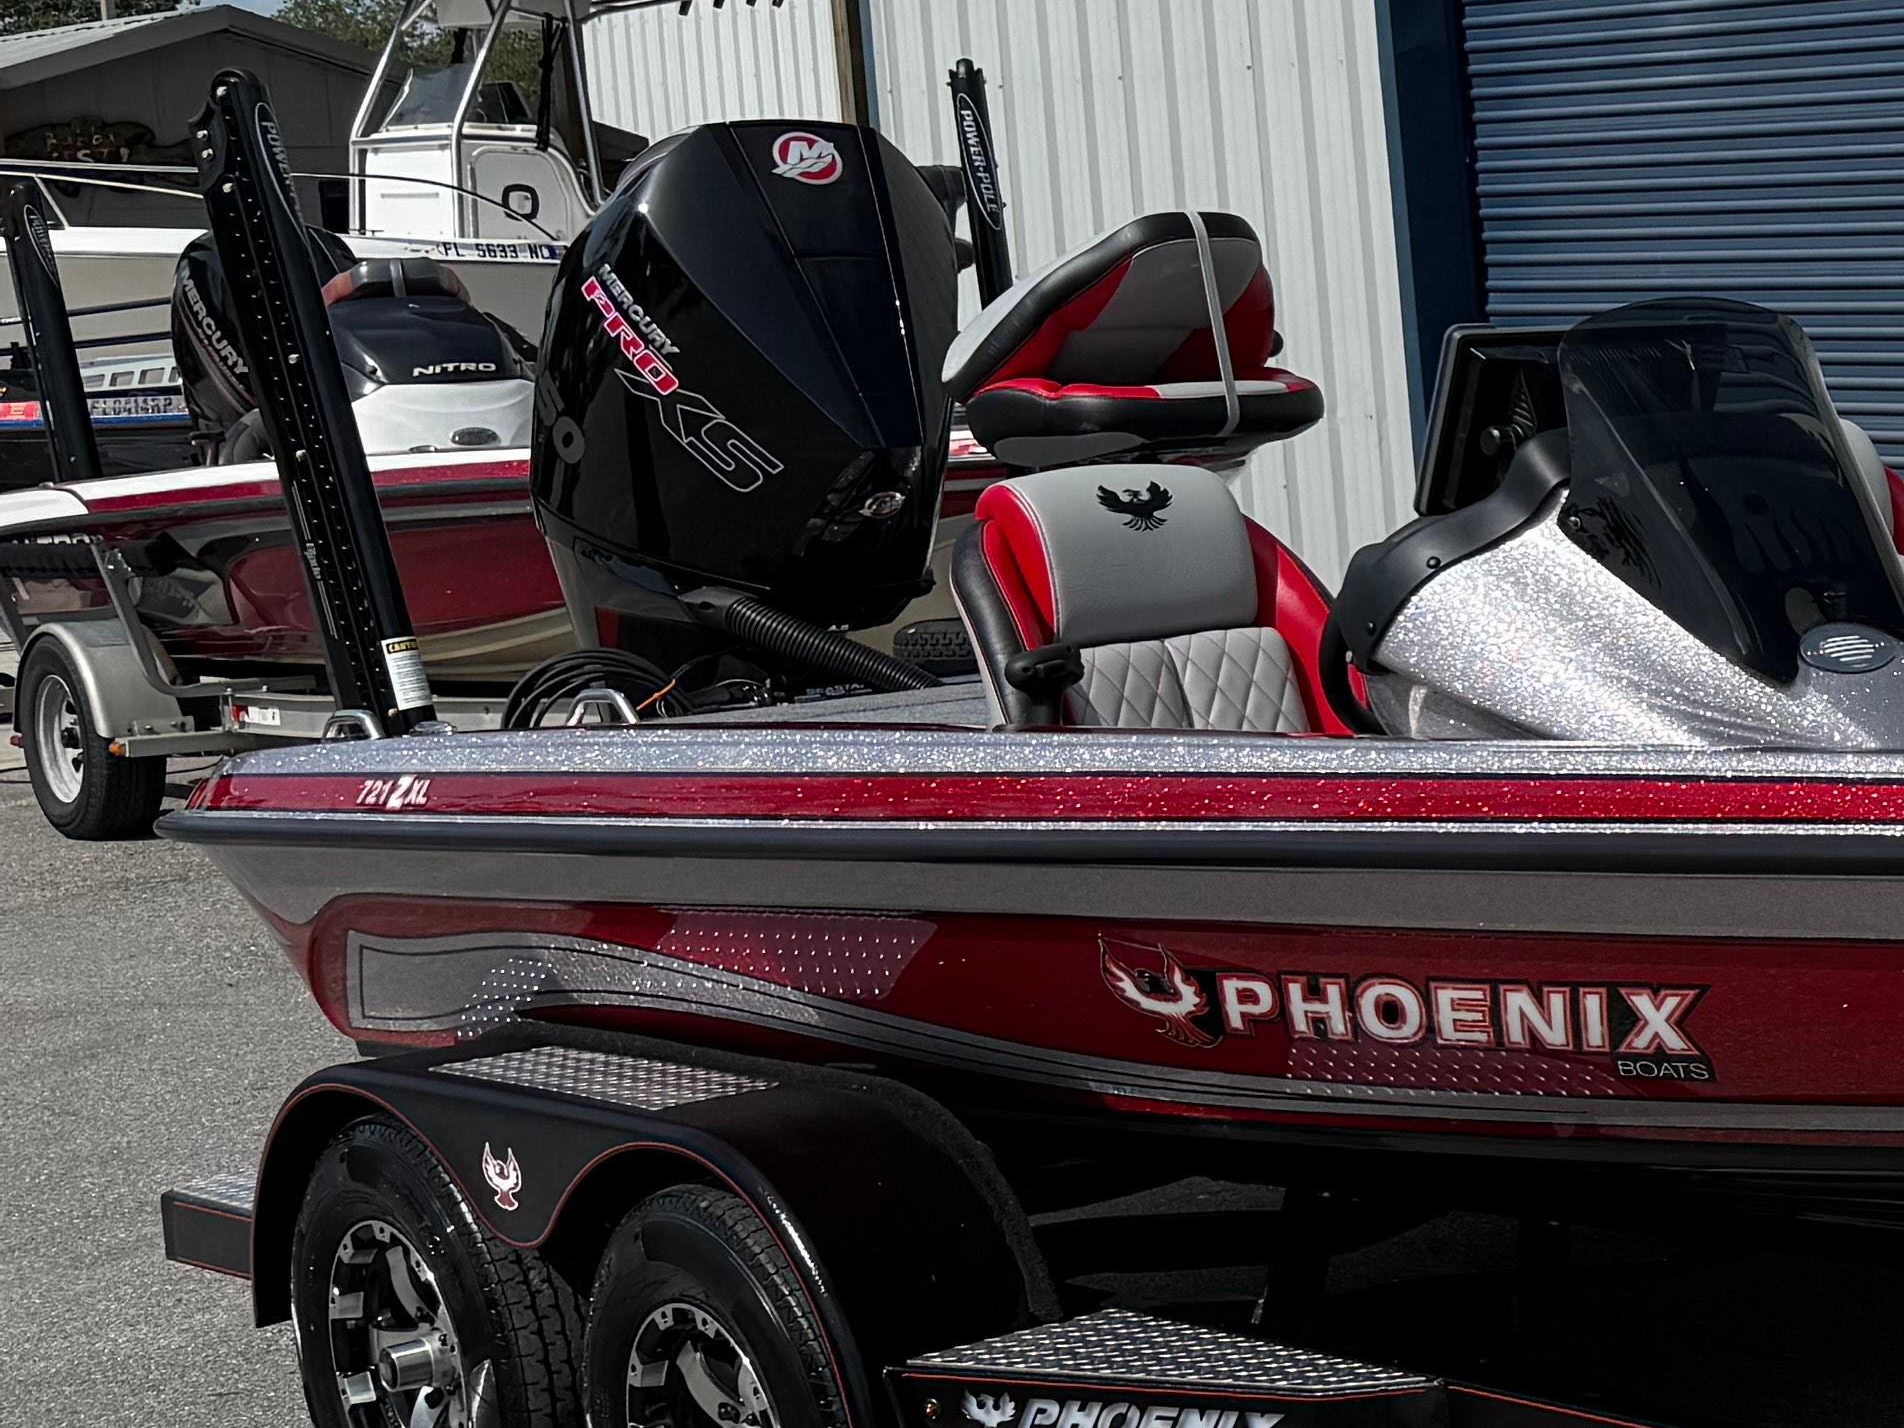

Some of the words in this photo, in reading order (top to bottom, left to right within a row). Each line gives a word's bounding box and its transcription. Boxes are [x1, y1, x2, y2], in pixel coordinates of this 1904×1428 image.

[181, 271, 250, 375] MERCURY
[581, 276, 679, 395] PRO
[599, 263, 680, 355] MERCURY
[412, 361, 497, 379] NITRO
[614, 368, 784, 493] XS
[1219, 973, 1703, 1056] PHOENIX
[1618, 1059, 1709, 1080] BOATS
